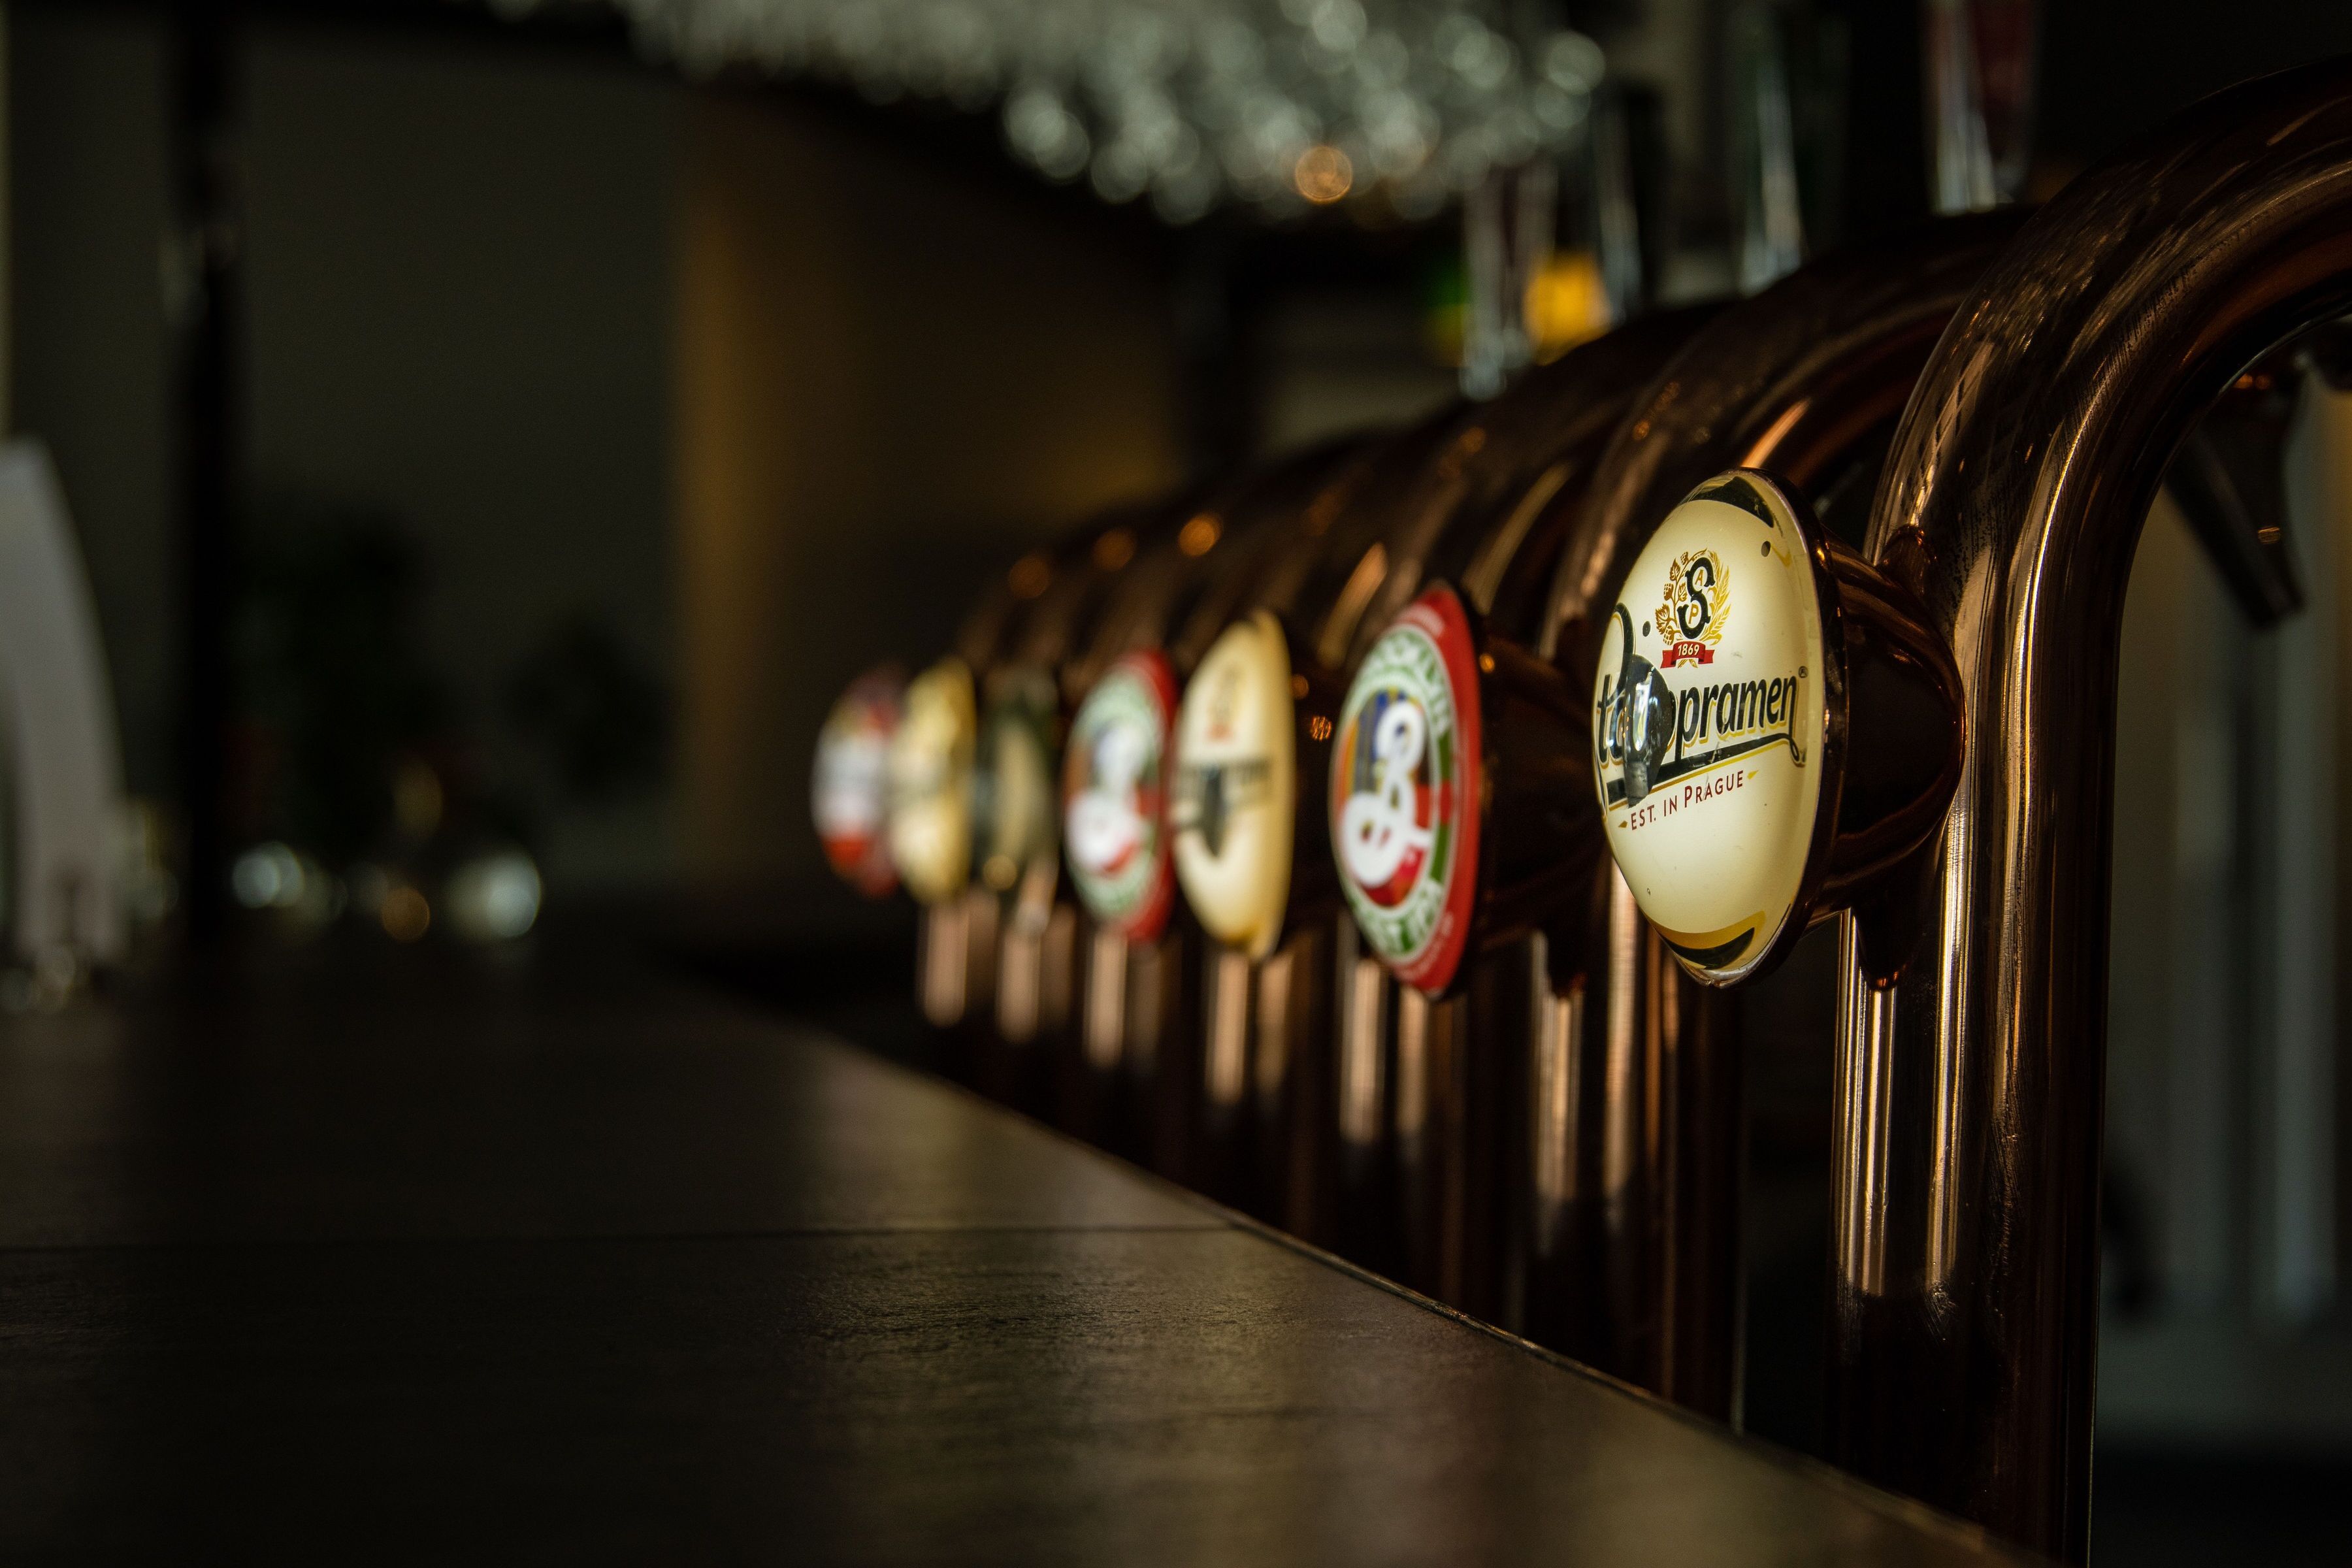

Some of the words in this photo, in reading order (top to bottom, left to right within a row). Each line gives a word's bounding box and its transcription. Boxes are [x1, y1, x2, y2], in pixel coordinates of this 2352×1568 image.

[1677, 643, 1700, 657] 1869
[1630, 804, 1656, 831] EST.
[1663, 794, 1678, 817] IN
[1684, 770, 1744, 808] PRAGUE
